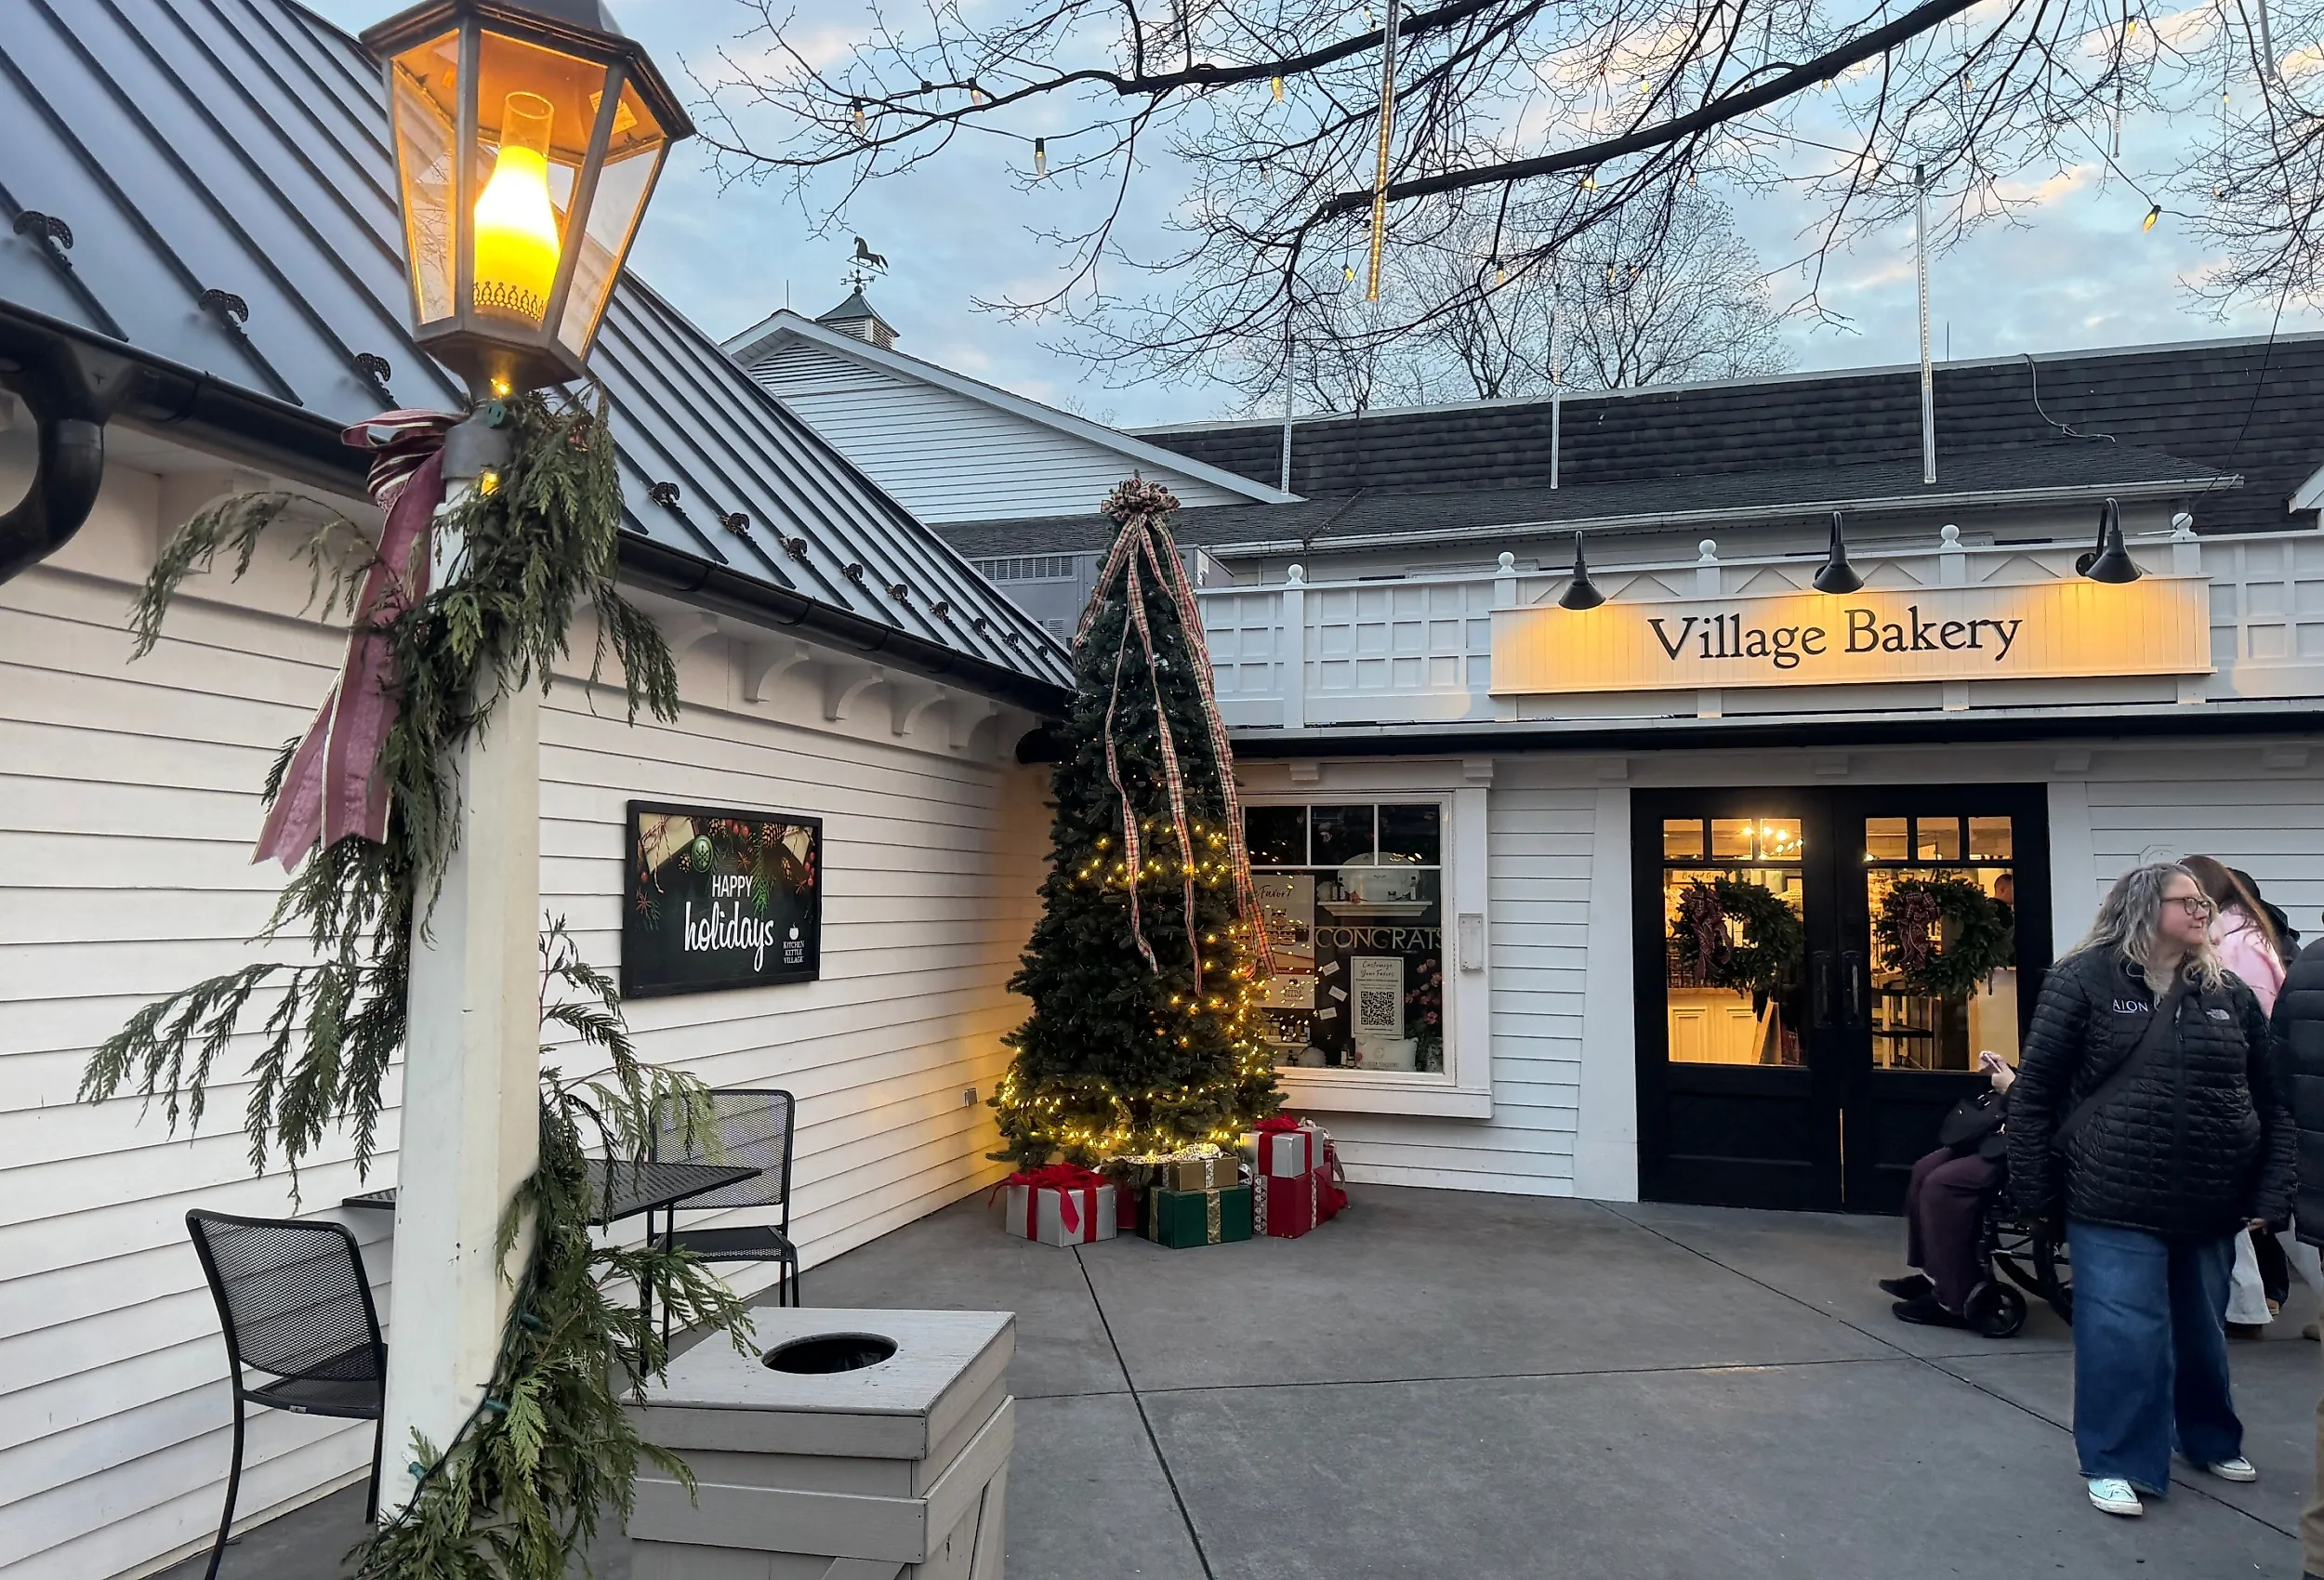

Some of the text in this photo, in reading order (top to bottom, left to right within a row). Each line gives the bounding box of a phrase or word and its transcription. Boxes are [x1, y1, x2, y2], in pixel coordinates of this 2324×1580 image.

[1646, 605, 2024, 670] Village Bakery
[711, 875, 754, 898] HAPPY
[684, 901, 774, 972] holidays
[783, 941, 805, 949] KITCHEN
[785, 948, 803, 956] KETTLE
[2113, 999, 2148, 1012] AION
